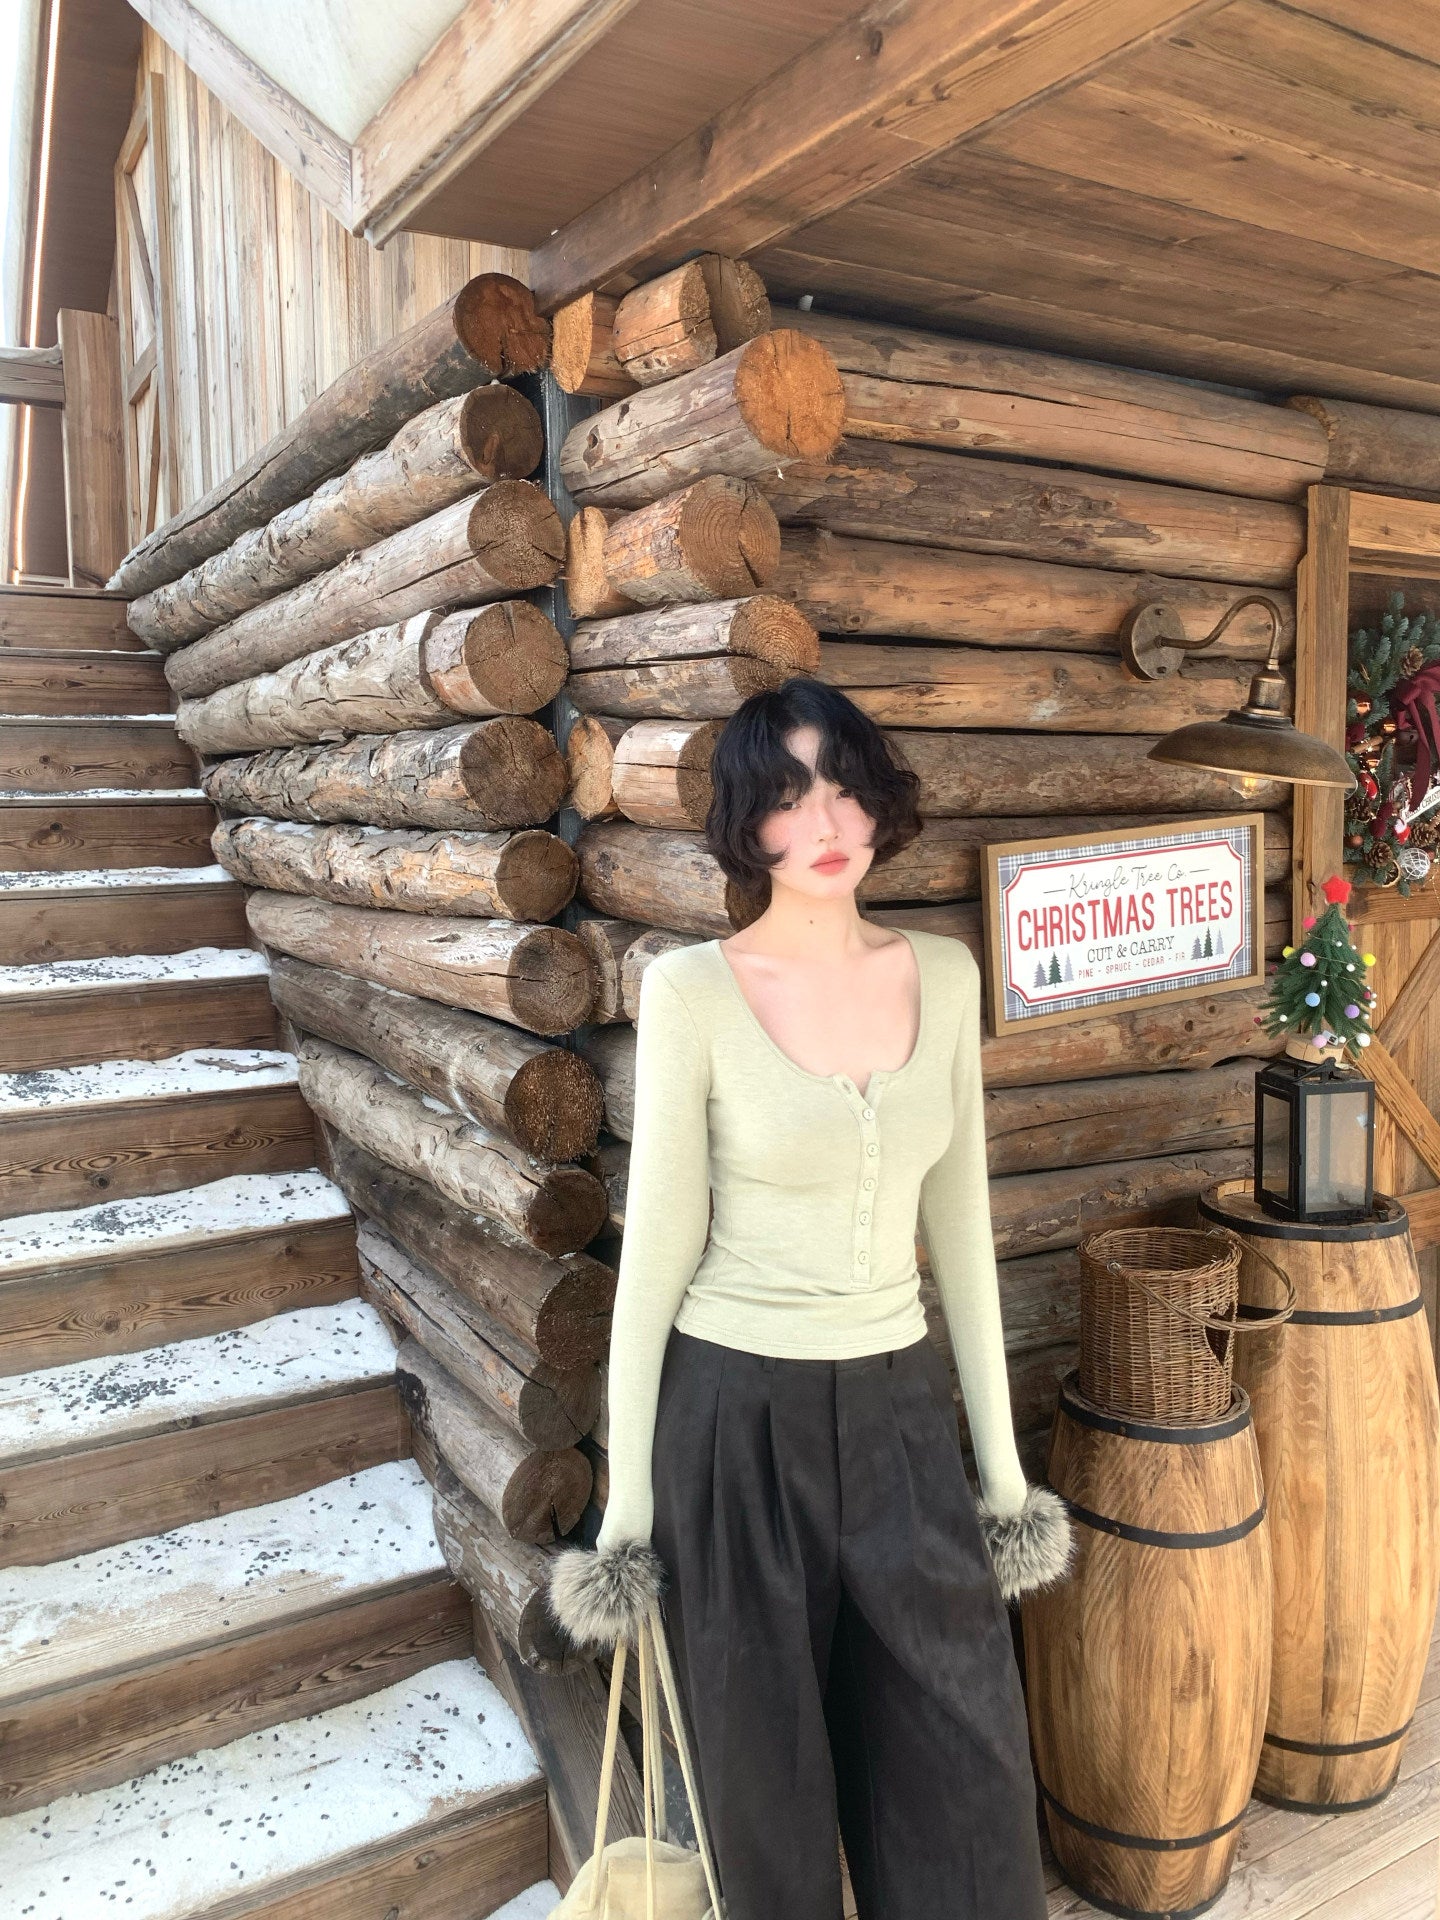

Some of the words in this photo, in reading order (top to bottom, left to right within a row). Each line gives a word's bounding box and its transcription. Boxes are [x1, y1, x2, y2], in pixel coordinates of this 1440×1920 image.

[1069, 865, 1130, 899] Kringle
[1131, 864, 1163, 890] Tree
[1167, 863, 1187, 882] Co.
[1017, 891, 1155, 951] CHRISTMAS
[1166, 880, 1233, 928] TREES
[1087, 945, 1113, 963] CUT
[1116, 943, 1127, 958] &
[1130, 935, 1175, 956] CARRY
[1078, 968, 1094, 979] PINE
[1105, 961, 1132, 975] SPRUCE
